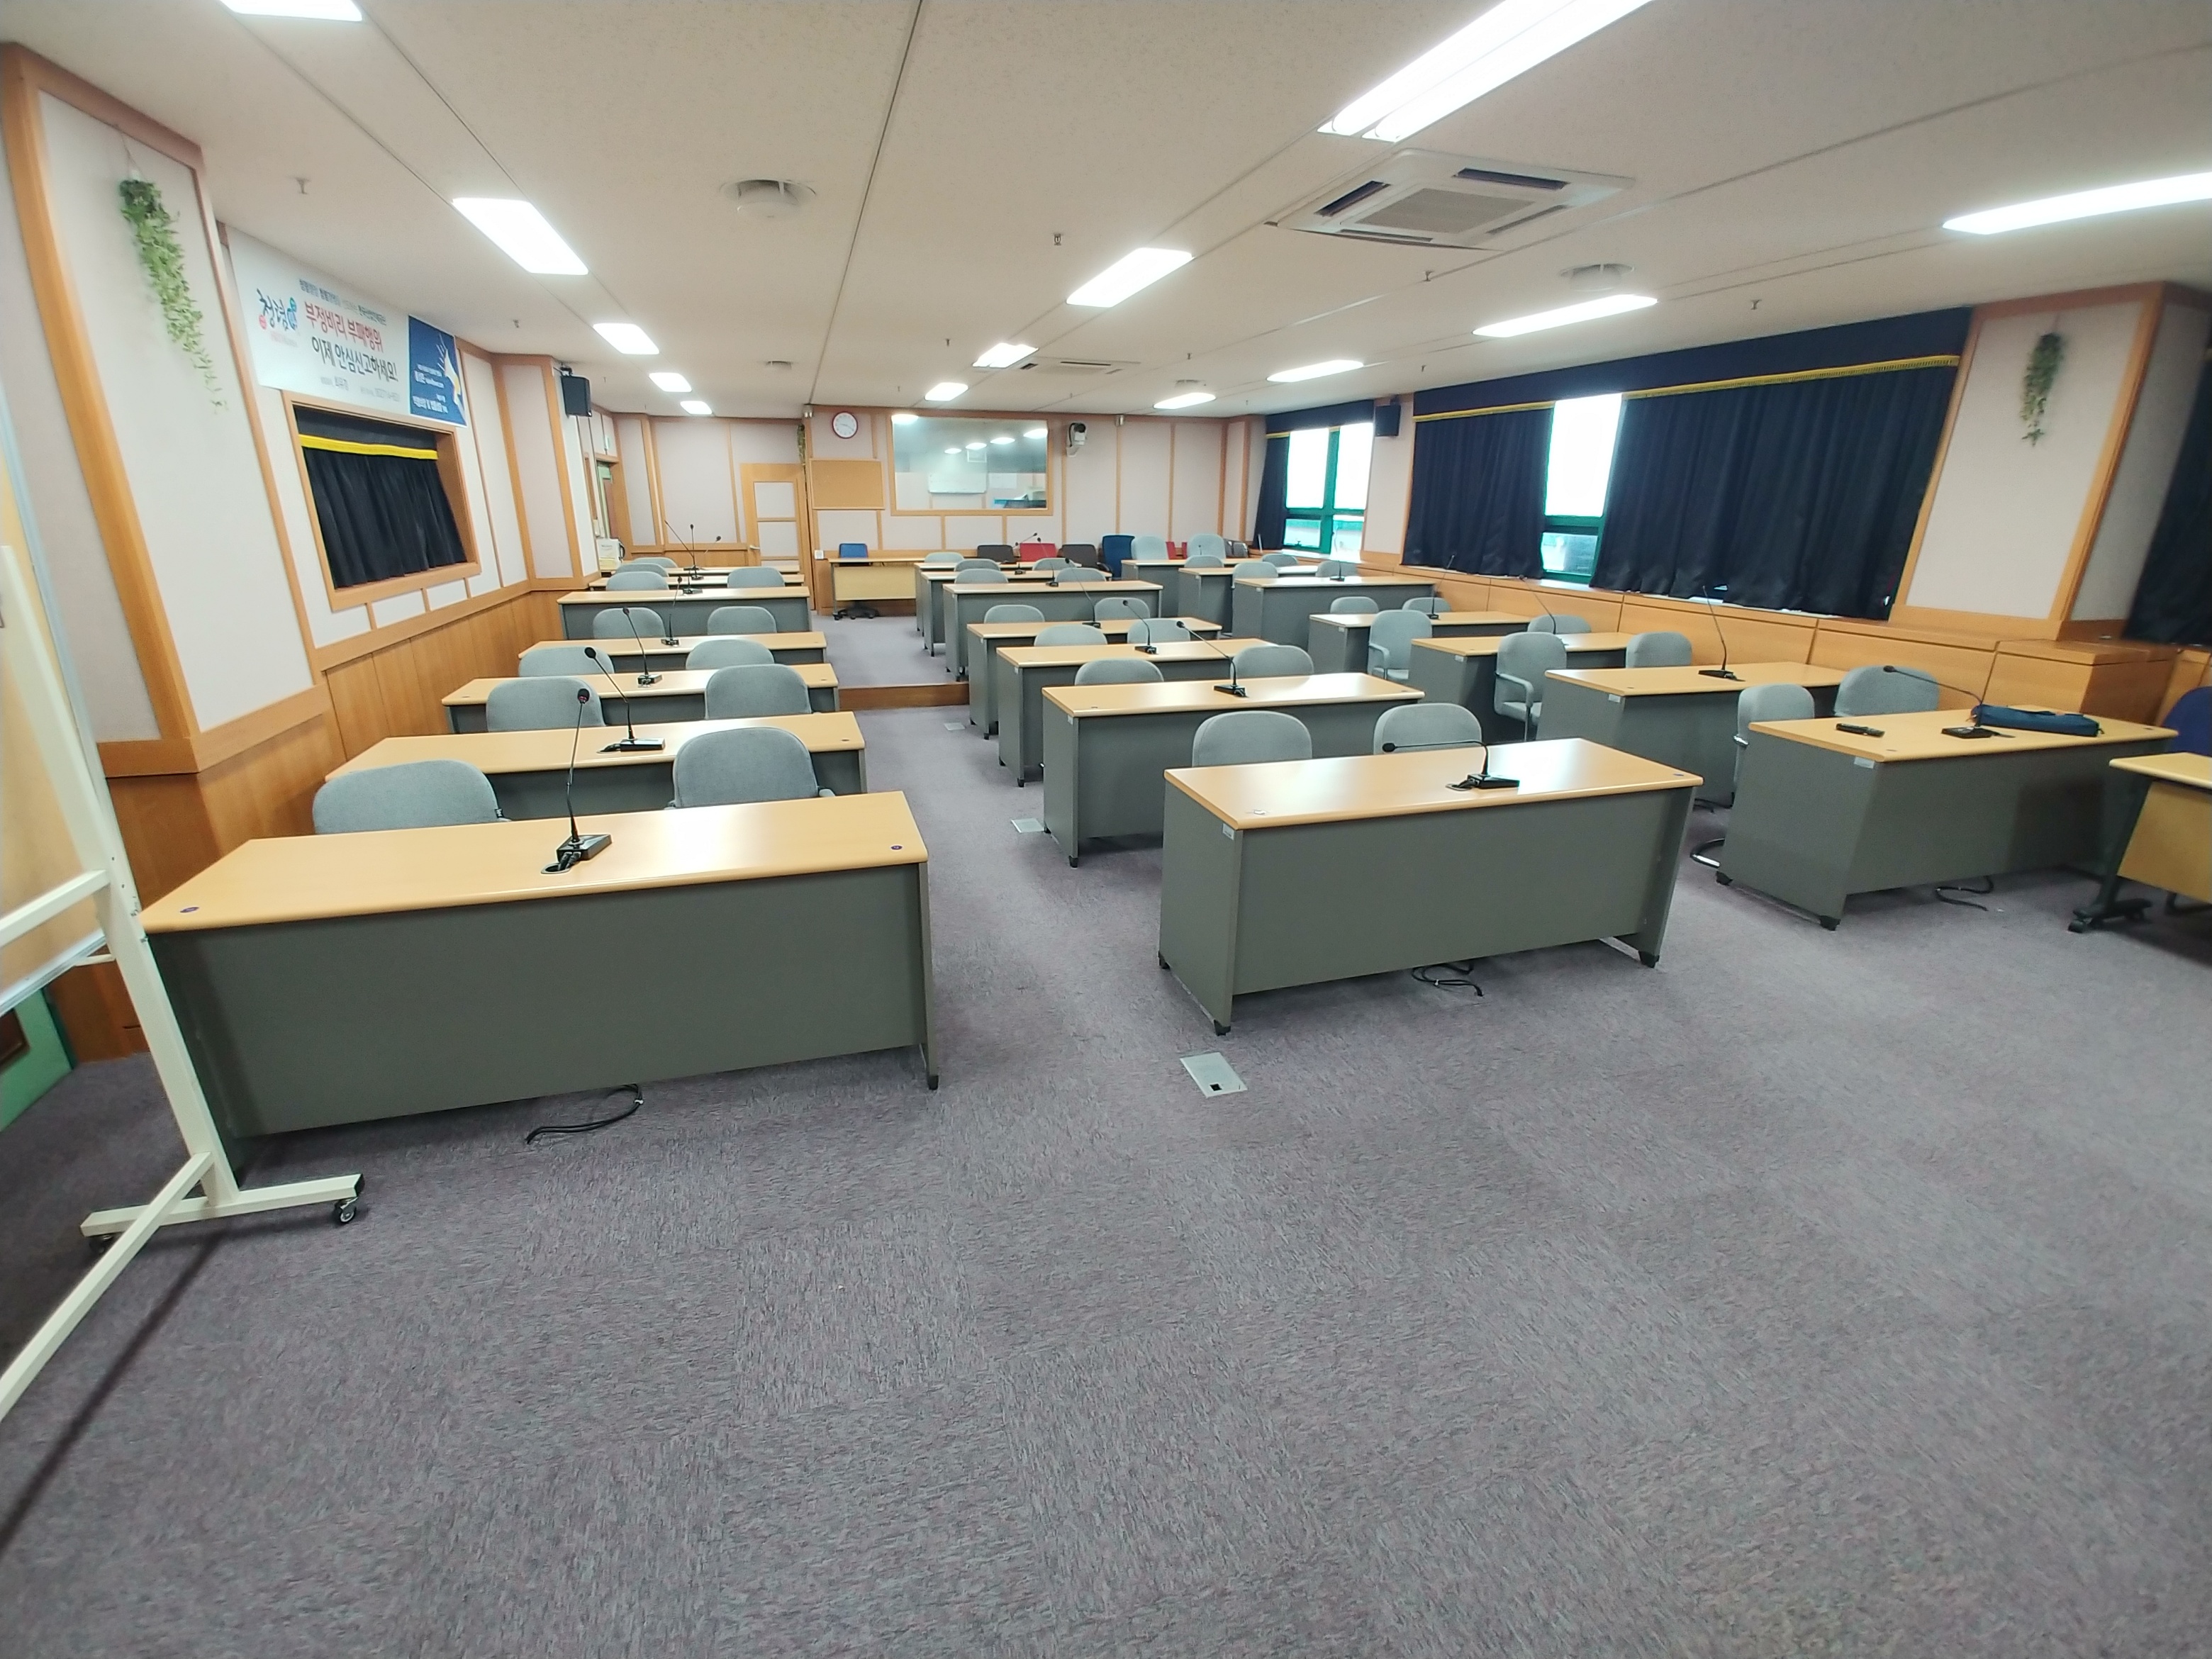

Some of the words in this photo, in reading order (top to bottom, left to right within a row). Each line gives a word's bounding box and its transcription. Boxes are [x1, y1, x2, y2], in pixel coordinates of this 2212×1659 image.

[304, 301, 347, 340] 부정비리
[347, 318, 384, 353] 부패행위
[312, 336, 335, 367] 이제
[335, 344, 398, 381] 안심신고하세요!
